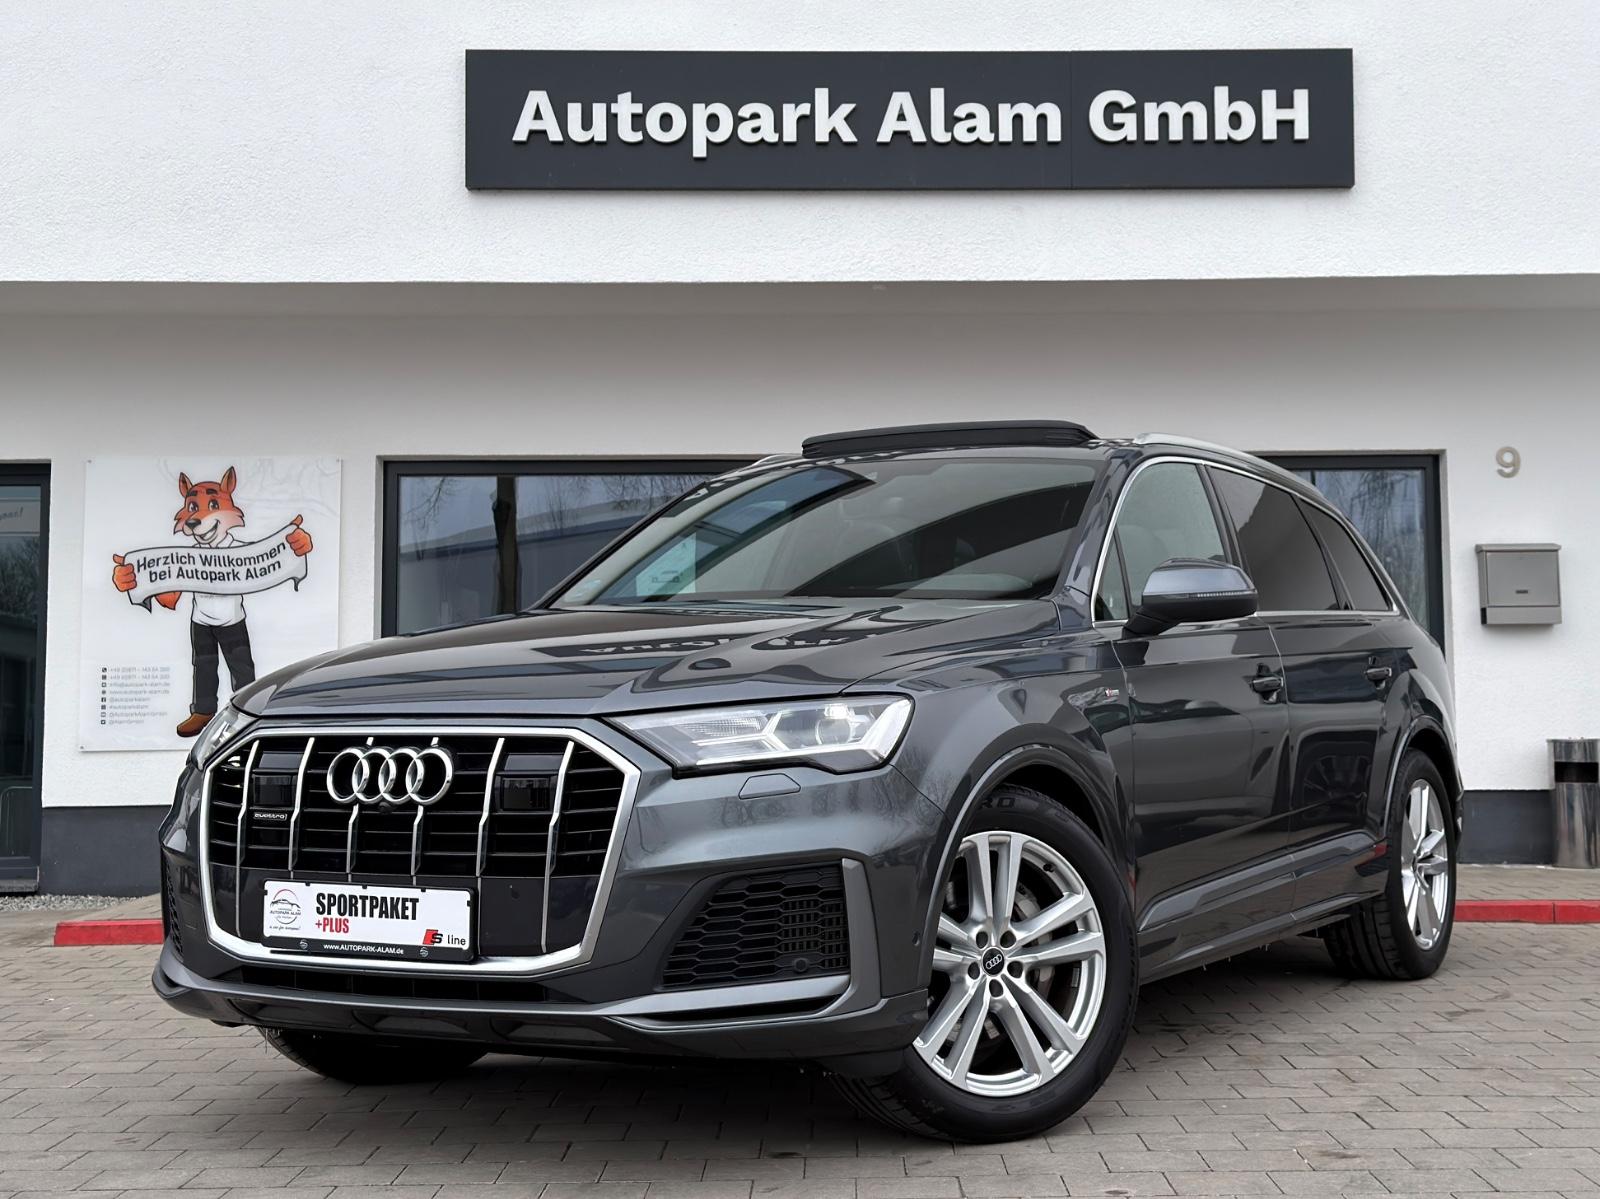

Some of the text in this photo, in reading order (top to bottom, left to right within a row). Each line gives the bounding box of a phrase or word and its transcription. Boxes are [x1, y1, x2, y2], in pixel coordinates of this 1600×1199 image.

[512, 86, 1311, 159] Autopark Alam GmbH
[1496, 446, 1521, 479] 9
[136, 542, 287, 573] Herzlich Willkommen
[149, 559, 282, 584] bei Autopark Alam
[254, 812, 287, 820] quattro
[316, 892, 420, 920] SPORTPAKET
[315, 917, 350, 934] +PLUS
[323, 944, 404, 955] www.AUTOPARK-ALAM.de
[431, 932, 467, 946] S line
